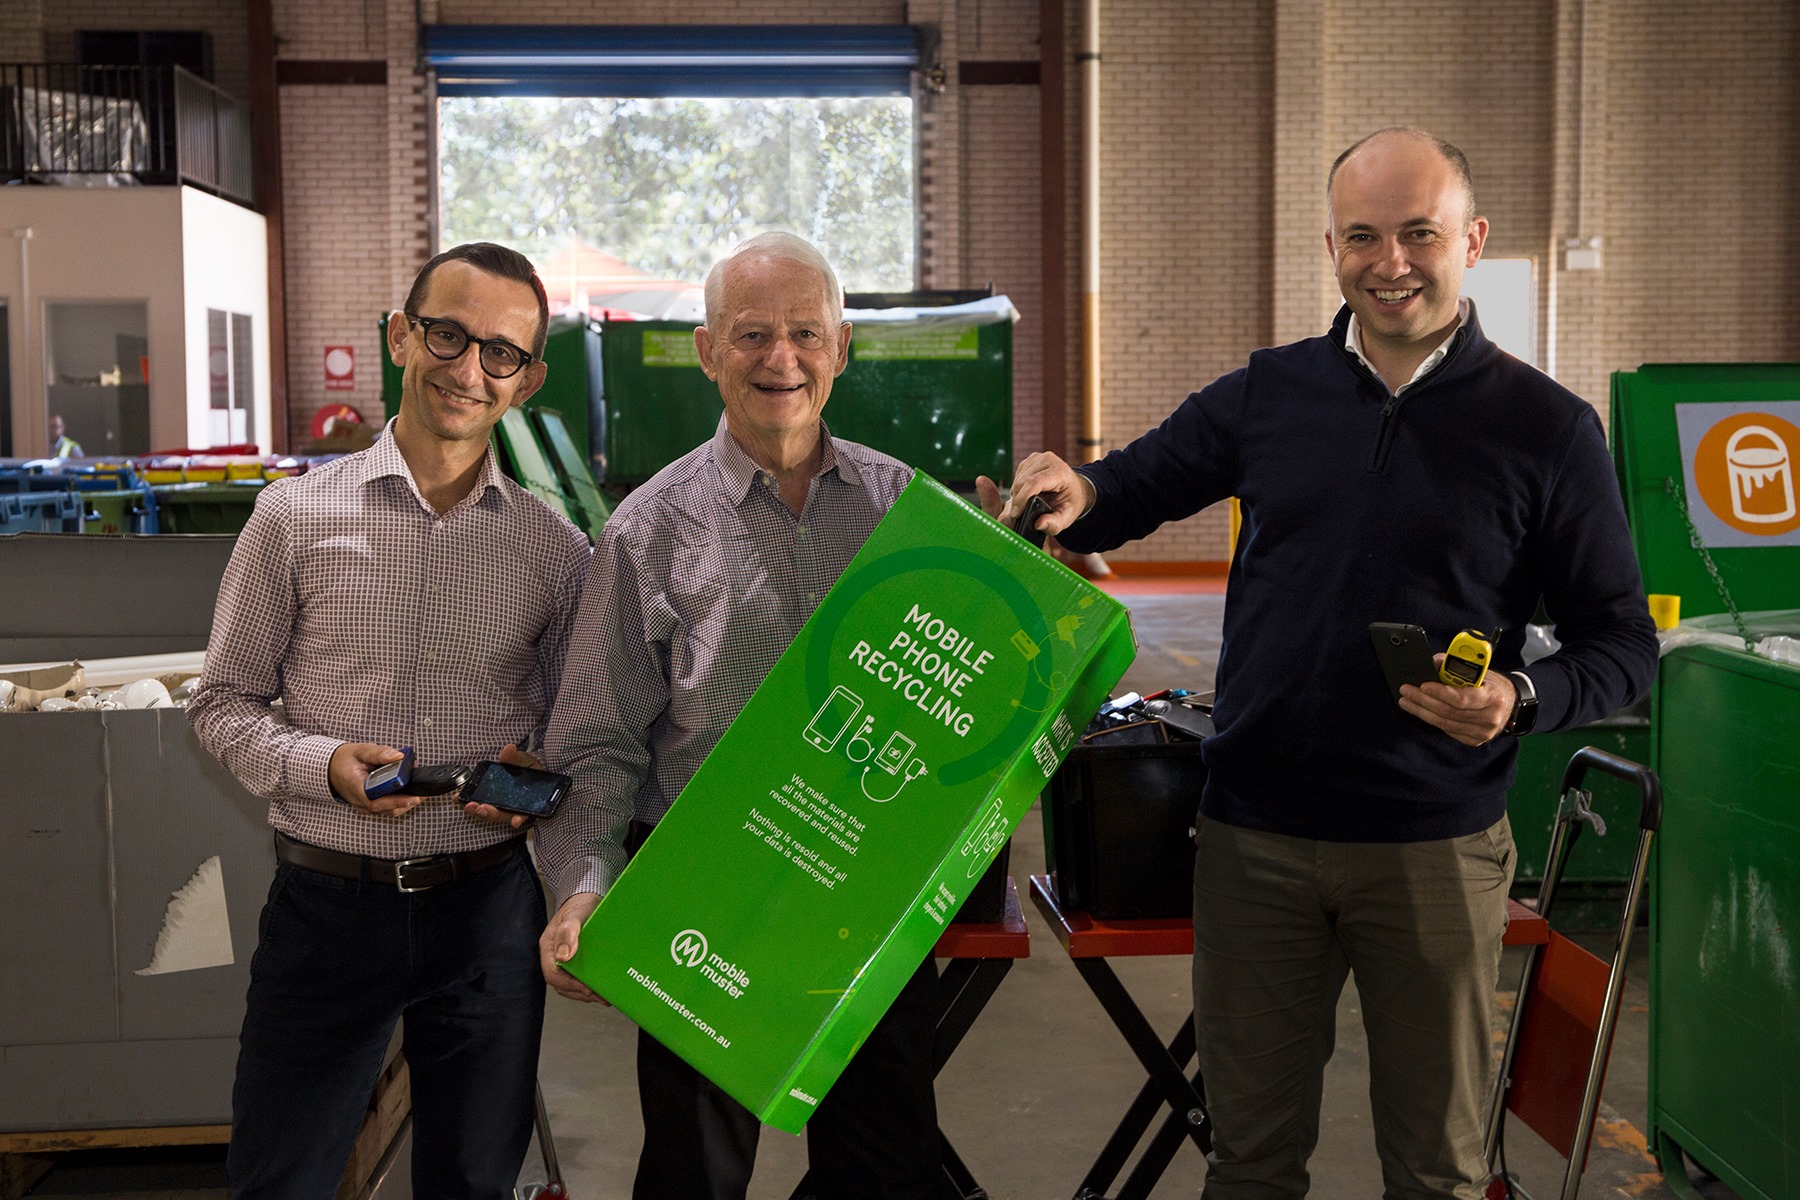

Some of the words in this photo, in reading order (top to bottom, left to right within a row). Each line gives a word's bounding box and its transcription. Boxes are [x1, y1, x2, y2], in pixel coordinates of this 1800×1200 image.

[888, 631, 973, 698] PHONE
[903, 604, 995, 675] MOBILE
[848, 640, 974, 737] RECYCLING
[1031, 731, 1059, 778] ACCEPTED
[1051, 708, 1072, 744] WHAT
[769, 789, 812, 822] recovered
[810, 819, 829, 834] and
[827, 826, 859, 856] reused.
[781, 784, 794, 794] all
[792, 791, 808, 805] the
[807, 802, 845, 832] materials
[845, 830, 860, 843] are
[791, 773, 805, 789] We
[805, 786, 829, 806] make
[828, 803, 848, 819] sure
[847, 815, 866, 832] that
[742, 821, 765, 837] your
[763, 835, 784, 852] data
[783, 847, 792, 858] is
[791, 855, 836, 890] destroyed.
[749, 808, 783, 838] Nothing
[783, 832, 792, 843] is
[791, 840, 820, 862] resold
[817, 860, 837, 874] and
[834, 872, 848, 882] all
[699, 964, 744, 999] muster
[707, 953, 750, 988] mobile
[626, 966, 732, 1049] mobilemuster.com.au
